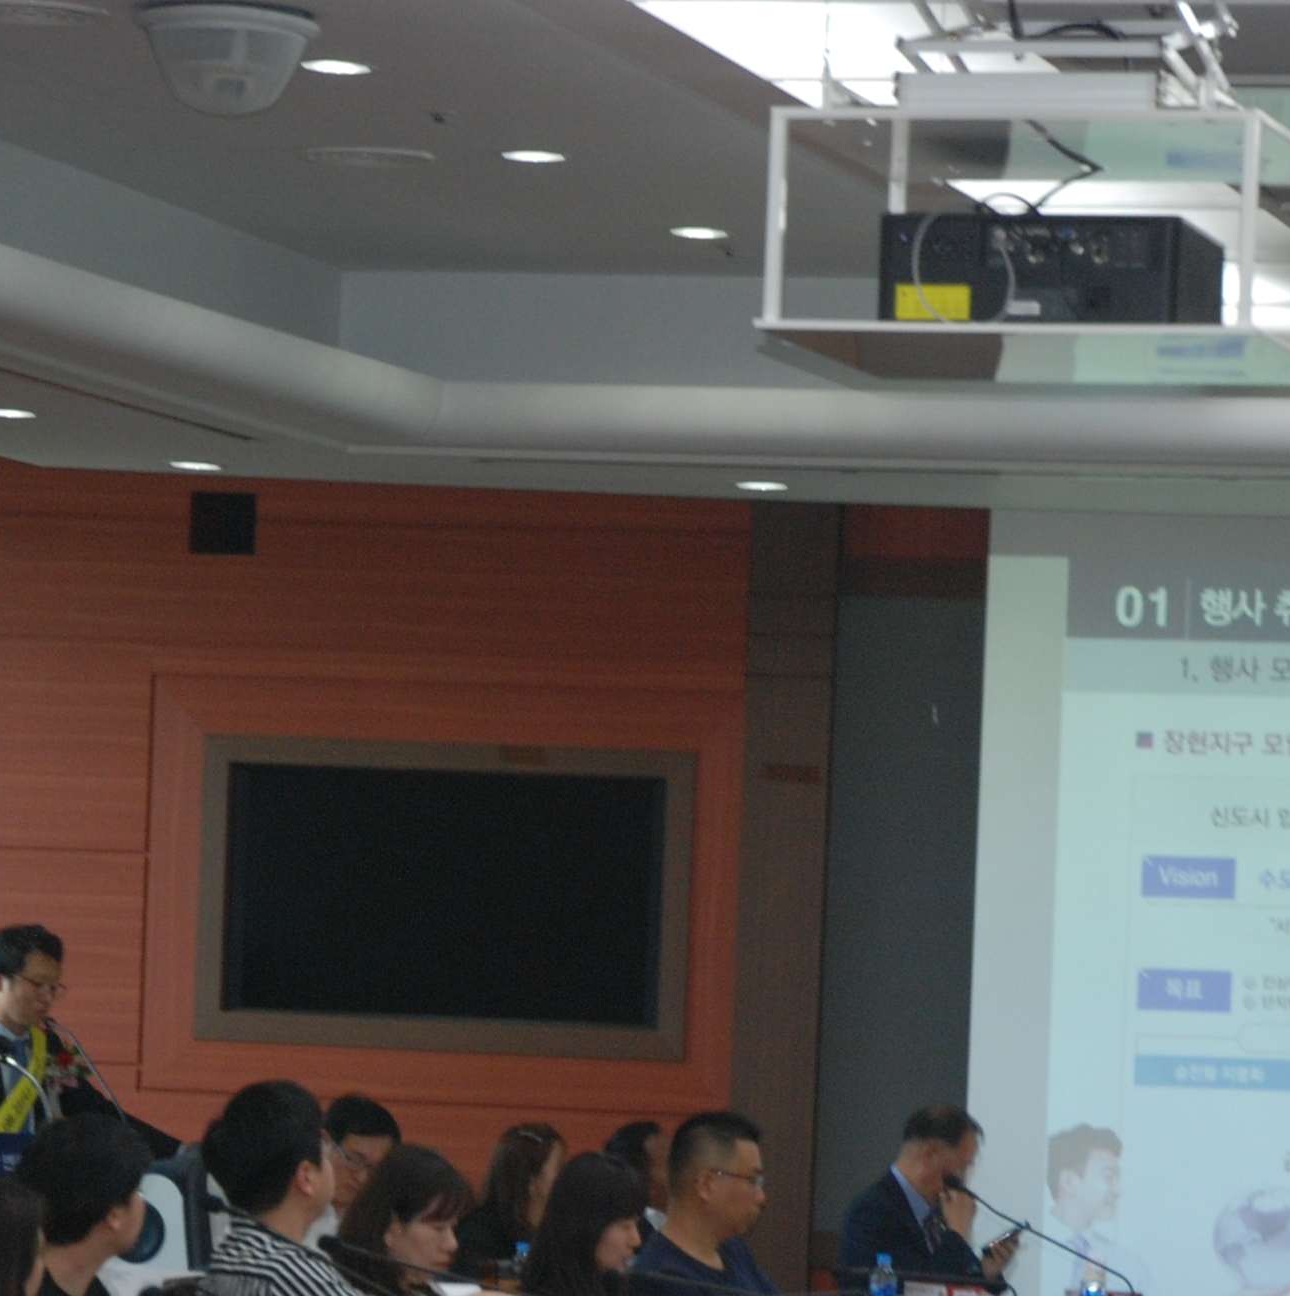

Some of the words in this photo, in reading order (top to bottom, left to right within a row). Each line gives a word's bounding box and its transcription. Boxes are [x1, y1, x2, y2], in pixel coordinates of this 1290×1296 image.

[1116, 586, 1169, 628] 01
[1200, 587, 1266, 628] 행사
[1179, 657, 1199, 682] 1.
[1210, 658, 1258, 683] 행사
[1211, 807, 1269, 828] 신도시
[1159, 867, 1218, 887] Vision
